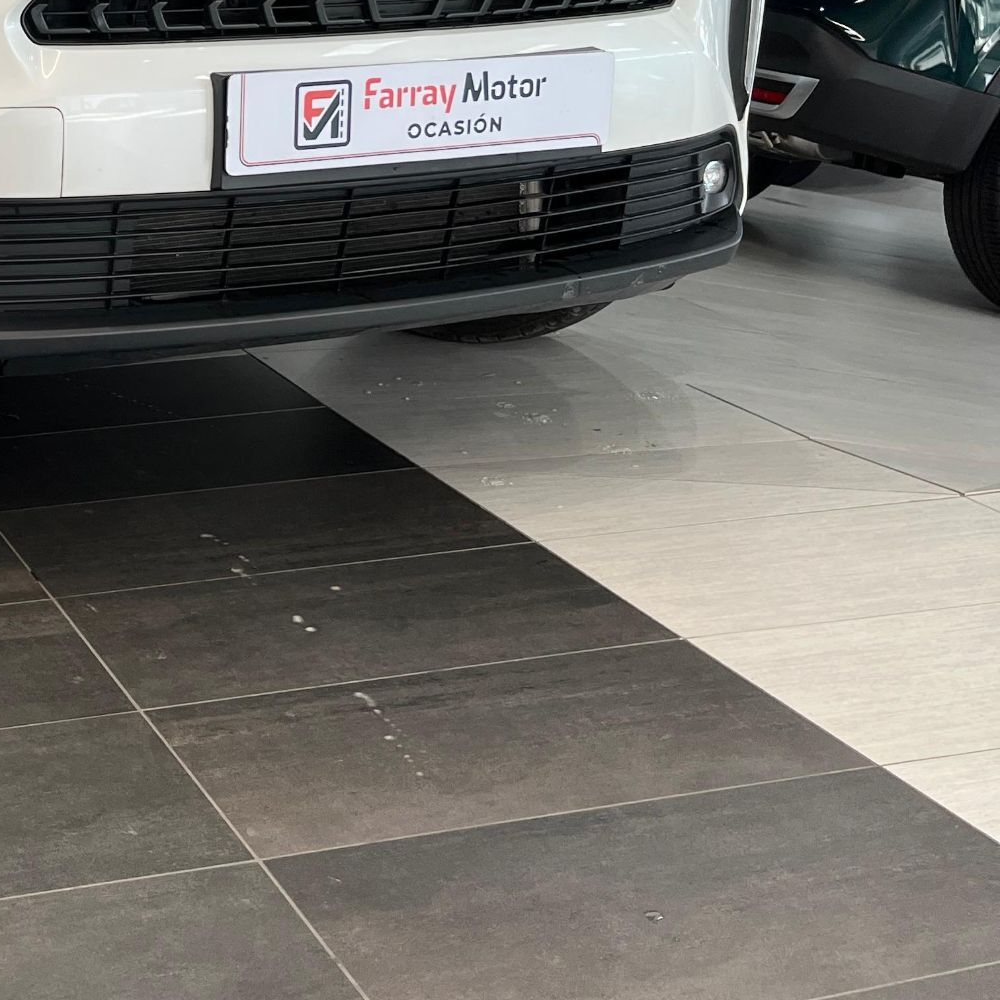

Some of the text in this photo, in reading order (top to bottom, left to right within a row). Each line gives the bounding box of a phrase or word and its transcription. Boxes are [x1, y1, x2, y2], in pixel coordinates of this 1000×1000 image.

[363, 70, 547, 113] Farray Motor
[407, 113, 503, 139] OCASIÓN
